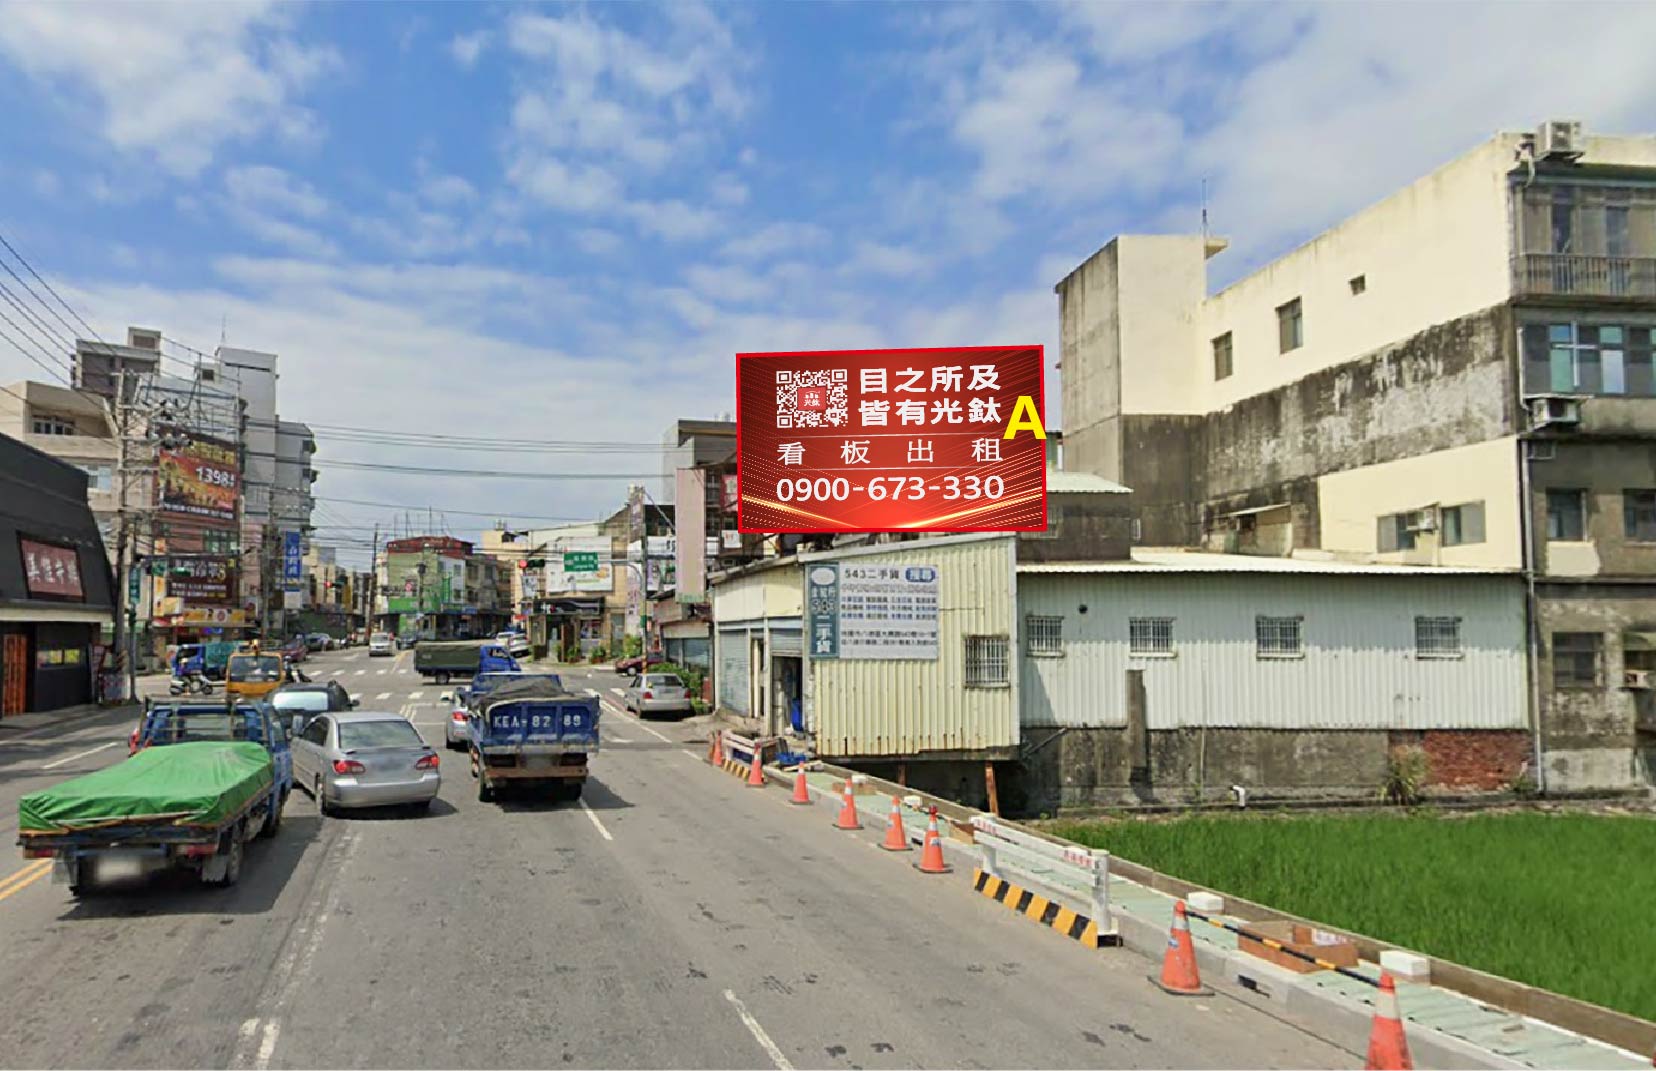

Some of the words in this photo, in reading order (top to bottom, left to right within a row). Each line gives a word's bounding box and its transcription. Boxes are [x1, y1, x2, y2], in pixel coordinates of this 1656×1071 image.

[859, 364, 1002, 393] 目之所及
[858, 397, 1002, 427] 皆有光鈦
[777, 438, 1003, 466] 看板出租
[776, 475, 1004, 502] 0900-673-330
